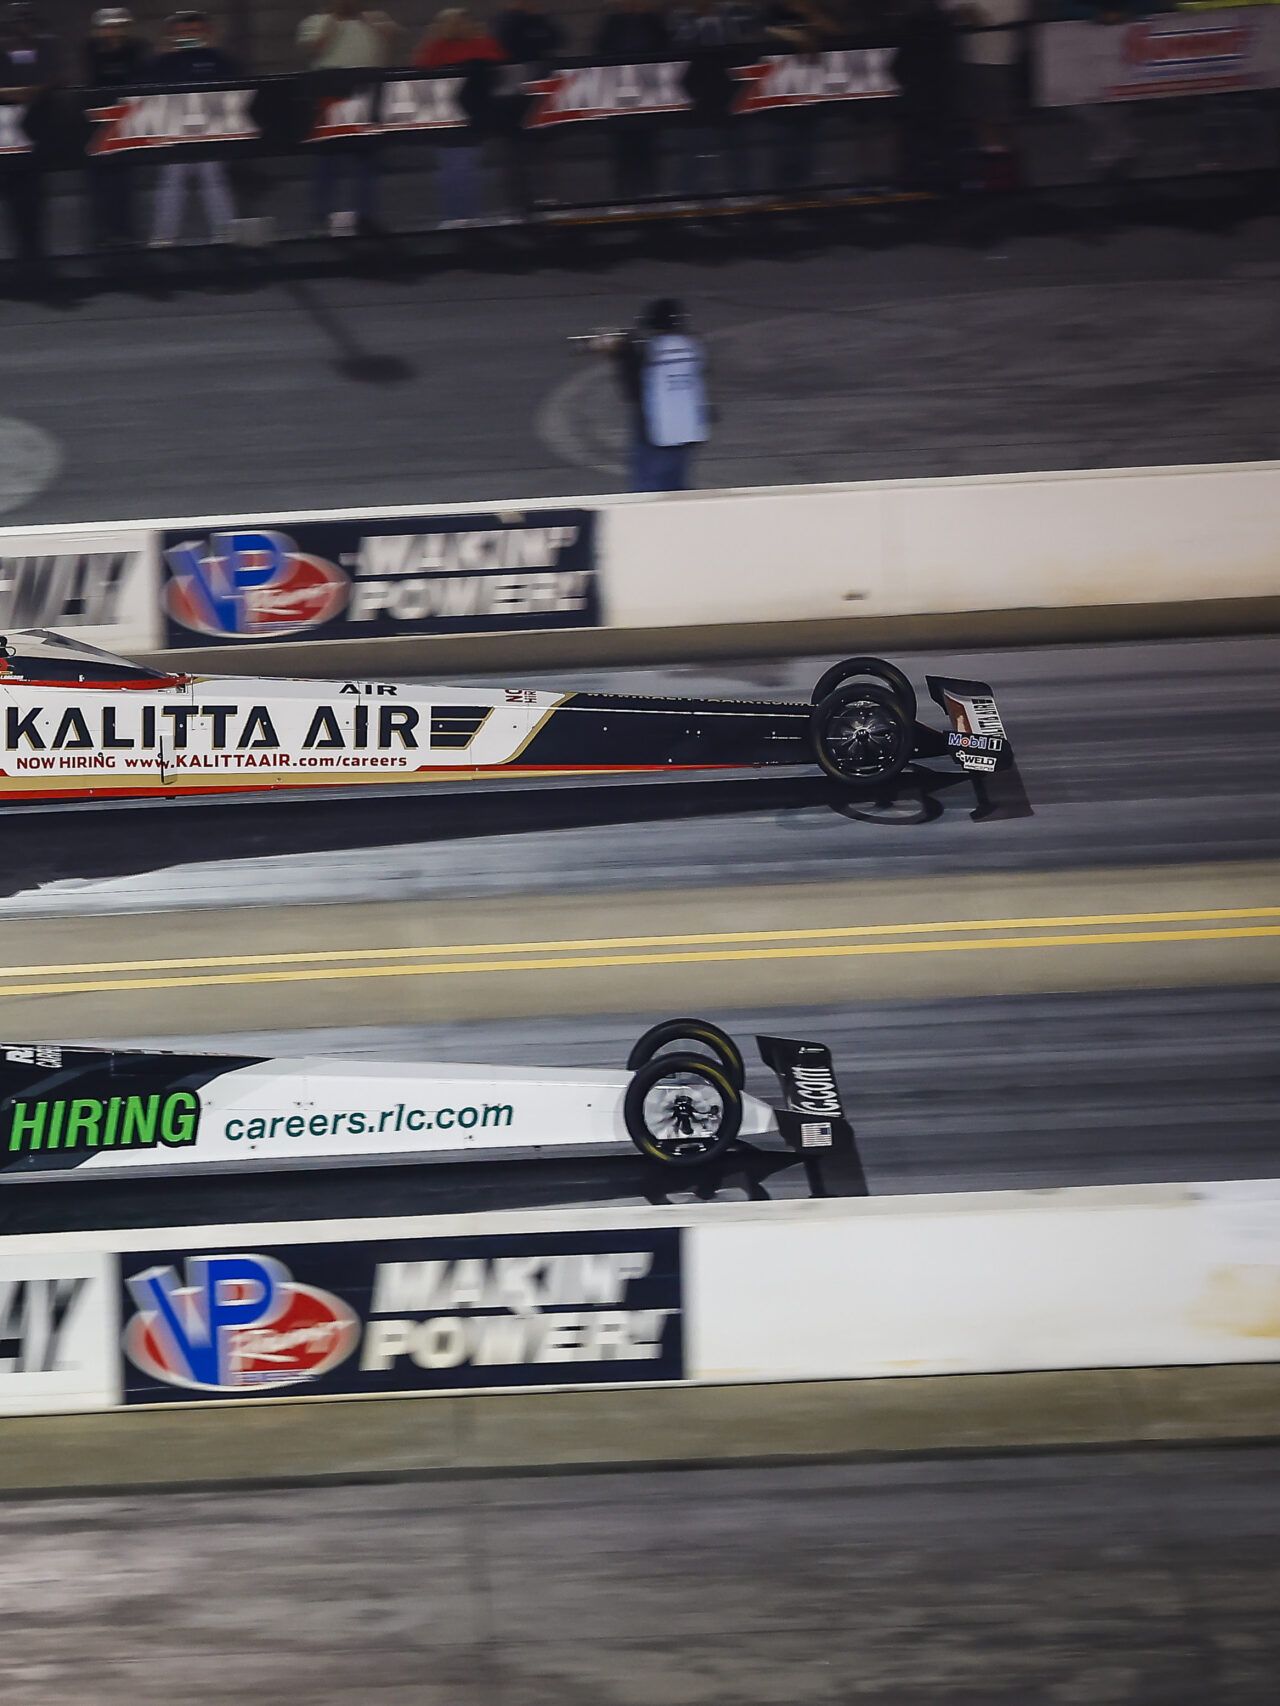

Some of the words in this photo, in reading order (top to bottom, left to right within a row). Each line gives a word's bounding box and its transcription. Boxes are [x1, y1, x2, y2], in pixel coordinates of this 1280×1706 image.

[339, 683, 398, 696] AIR
[6, 705, 281, 751] KALITTA
[301, 705, 421, 750] AIR
[948, 733, 987, 749] Mobil
[16, 756, 57, 770] NOW
[60, 756, 116, 769] HIRING
[964, 755, 995, 765] WELD
[8, 1091, 198, 1152] HIRING
[225, 1103, 514, 1142] careers.rlc.com
[128, 1254, 294, 1385] VP
